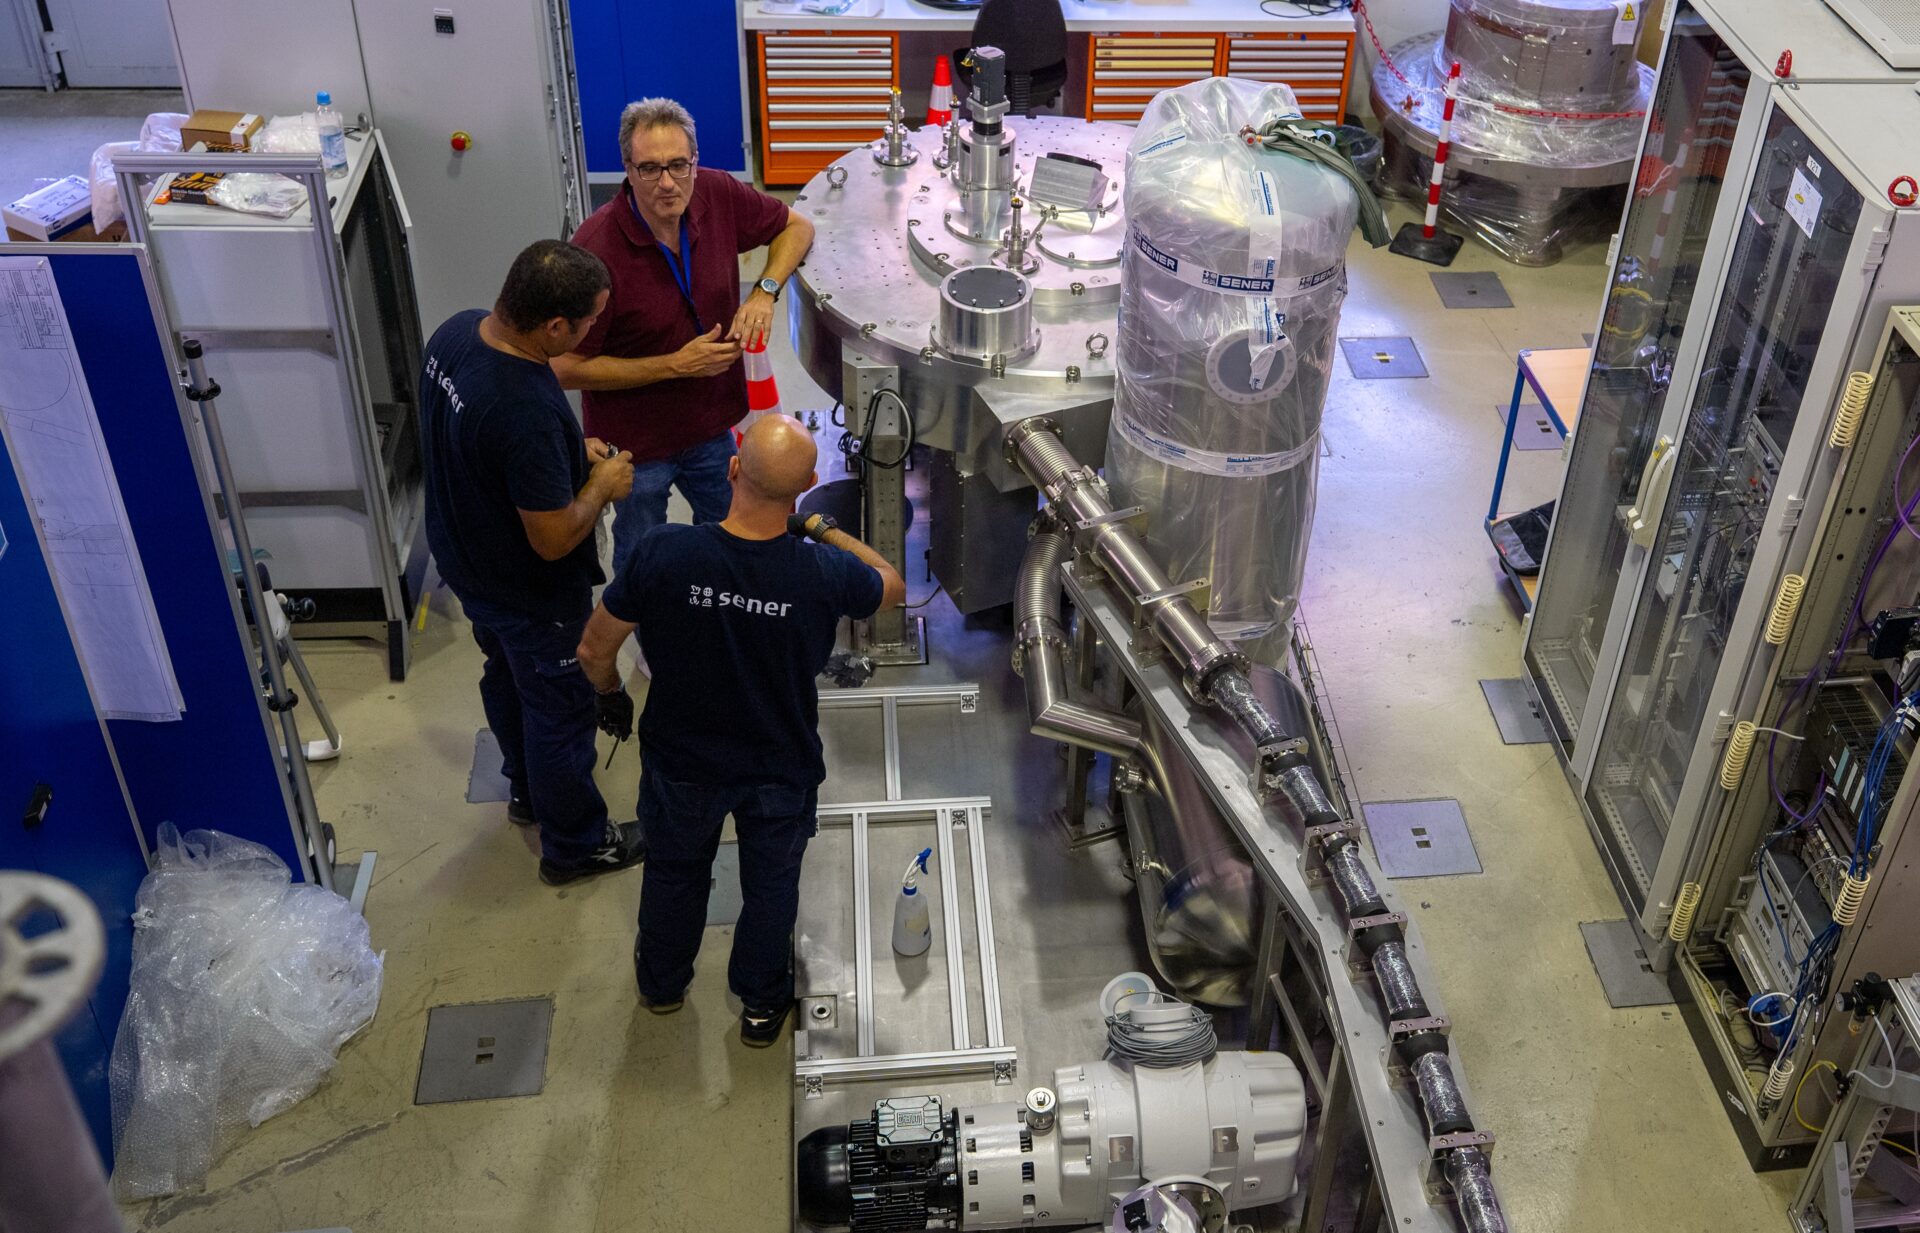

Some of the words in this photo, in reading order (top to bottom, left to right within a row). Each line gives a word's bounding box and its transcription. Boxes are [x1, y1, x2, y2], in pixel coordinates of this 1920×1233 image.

[1810, 160, 1819, 174] 121
[1141, 241, 1175, 270] SENER
[1220, 277, 1271, 291] SENER
[438, 370, 465, 414] sener
[718, 592, 793, 617] sener
